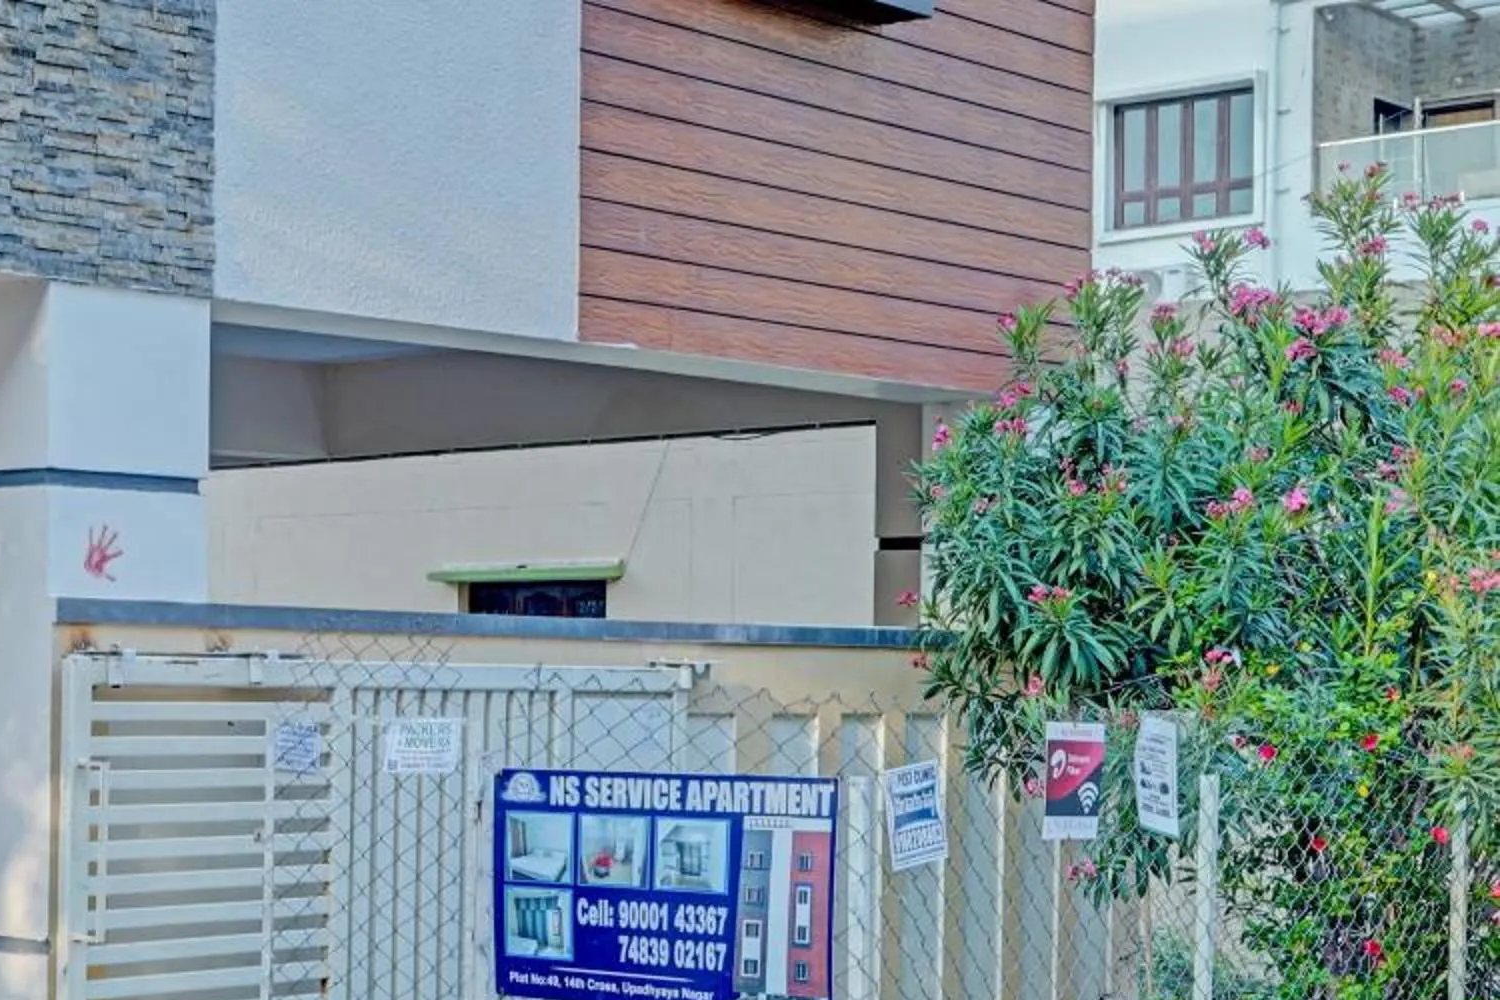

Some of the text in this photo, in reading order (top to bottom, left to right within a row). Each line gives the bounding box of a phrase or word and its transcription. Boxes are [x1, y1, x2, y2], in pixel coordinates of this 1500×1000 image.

[550, 775, 835, 817] NS SERVICE APARTMENT
[577, 897, 728, 936] Cell: 90001 43367
[618, 935, 727, 972] 74839 02167
